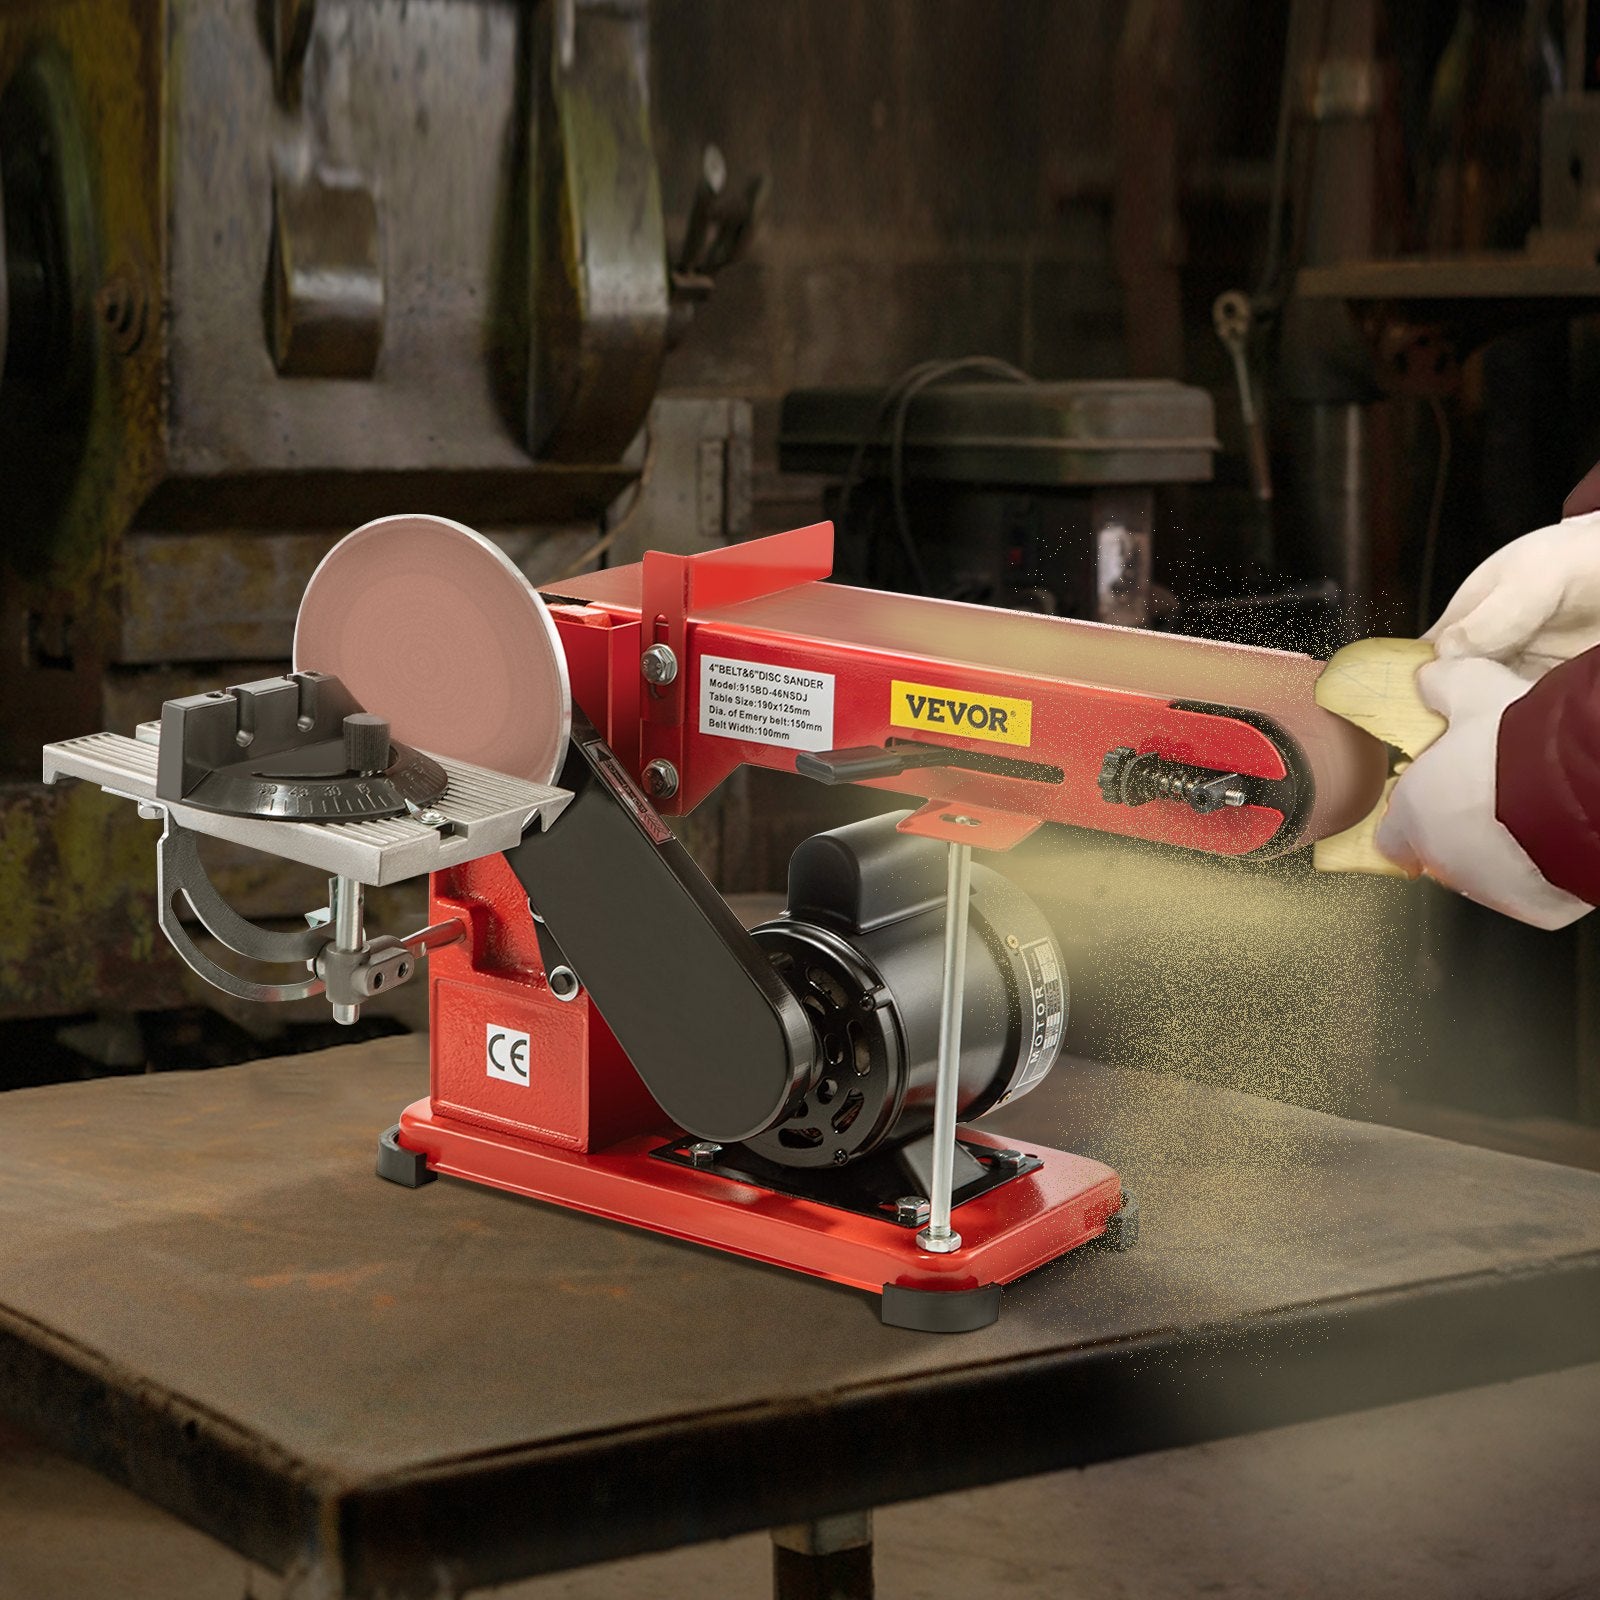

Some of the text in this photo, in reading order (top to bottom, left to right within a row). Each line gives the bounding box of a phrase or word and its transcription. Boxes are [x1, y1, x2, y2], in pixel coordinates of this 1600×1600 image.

[783, 674, 824, 689] SANDER
[709, 691, 811, 716] Table Size:190x125mm
[905, 693, 1008, 733] VEVOR
[708, 718, 790, 740] Belt Width:100mm
[709, 705, 822, 732] Dia. of Emery belt:150mm
[1029, 986, 1045, 1064] MOTOR
[488, 1033, 527, 1078] CE
